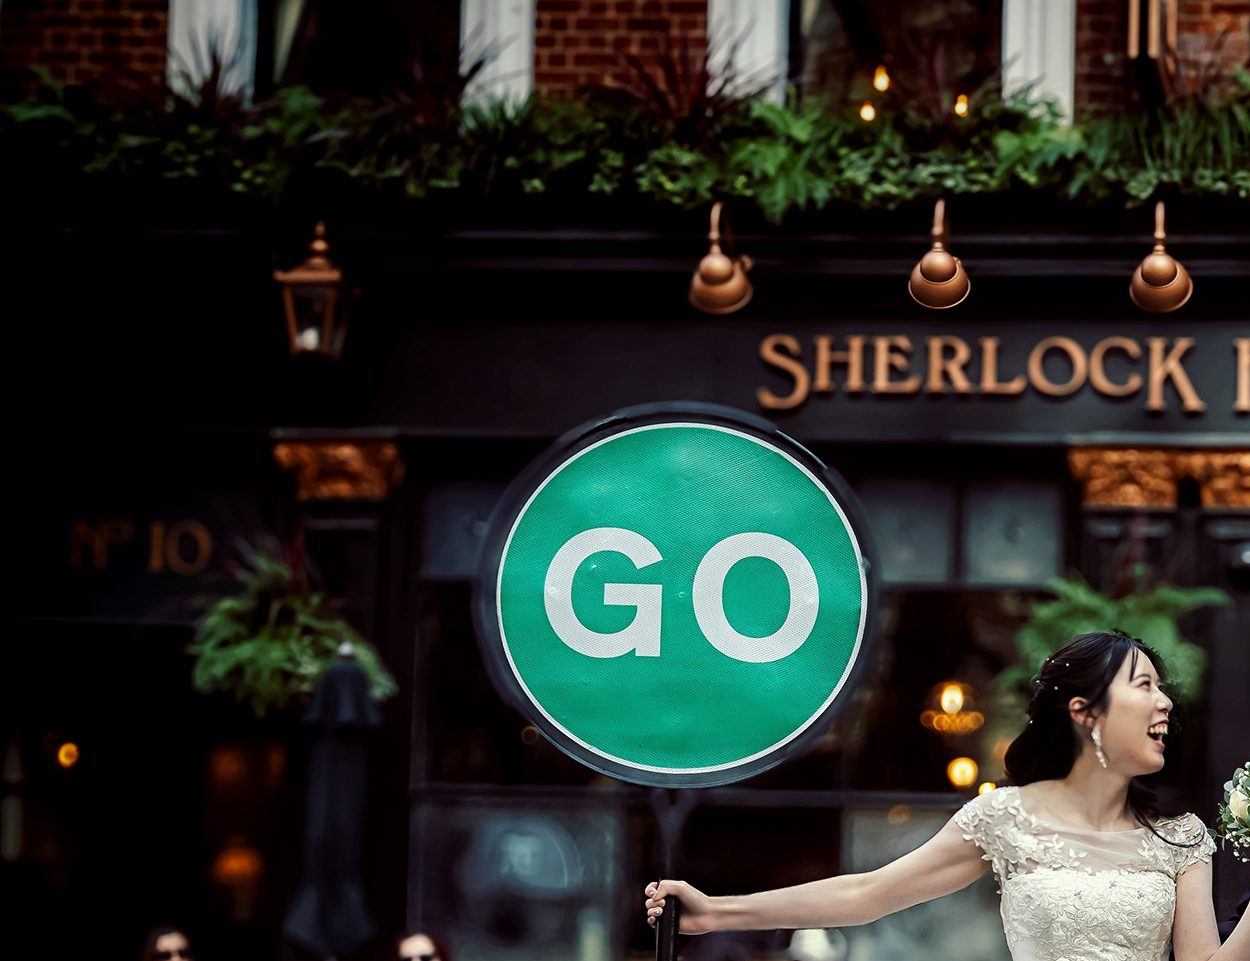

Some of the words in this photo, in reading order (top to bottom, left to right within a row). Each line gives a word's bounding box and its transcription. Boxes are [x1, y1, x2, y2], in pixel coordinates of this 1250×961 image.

[757, 333, 1206, 413] SHERLOCK
[147, 518, 214, 576] 10
[544, 527, 820, 664] GO
